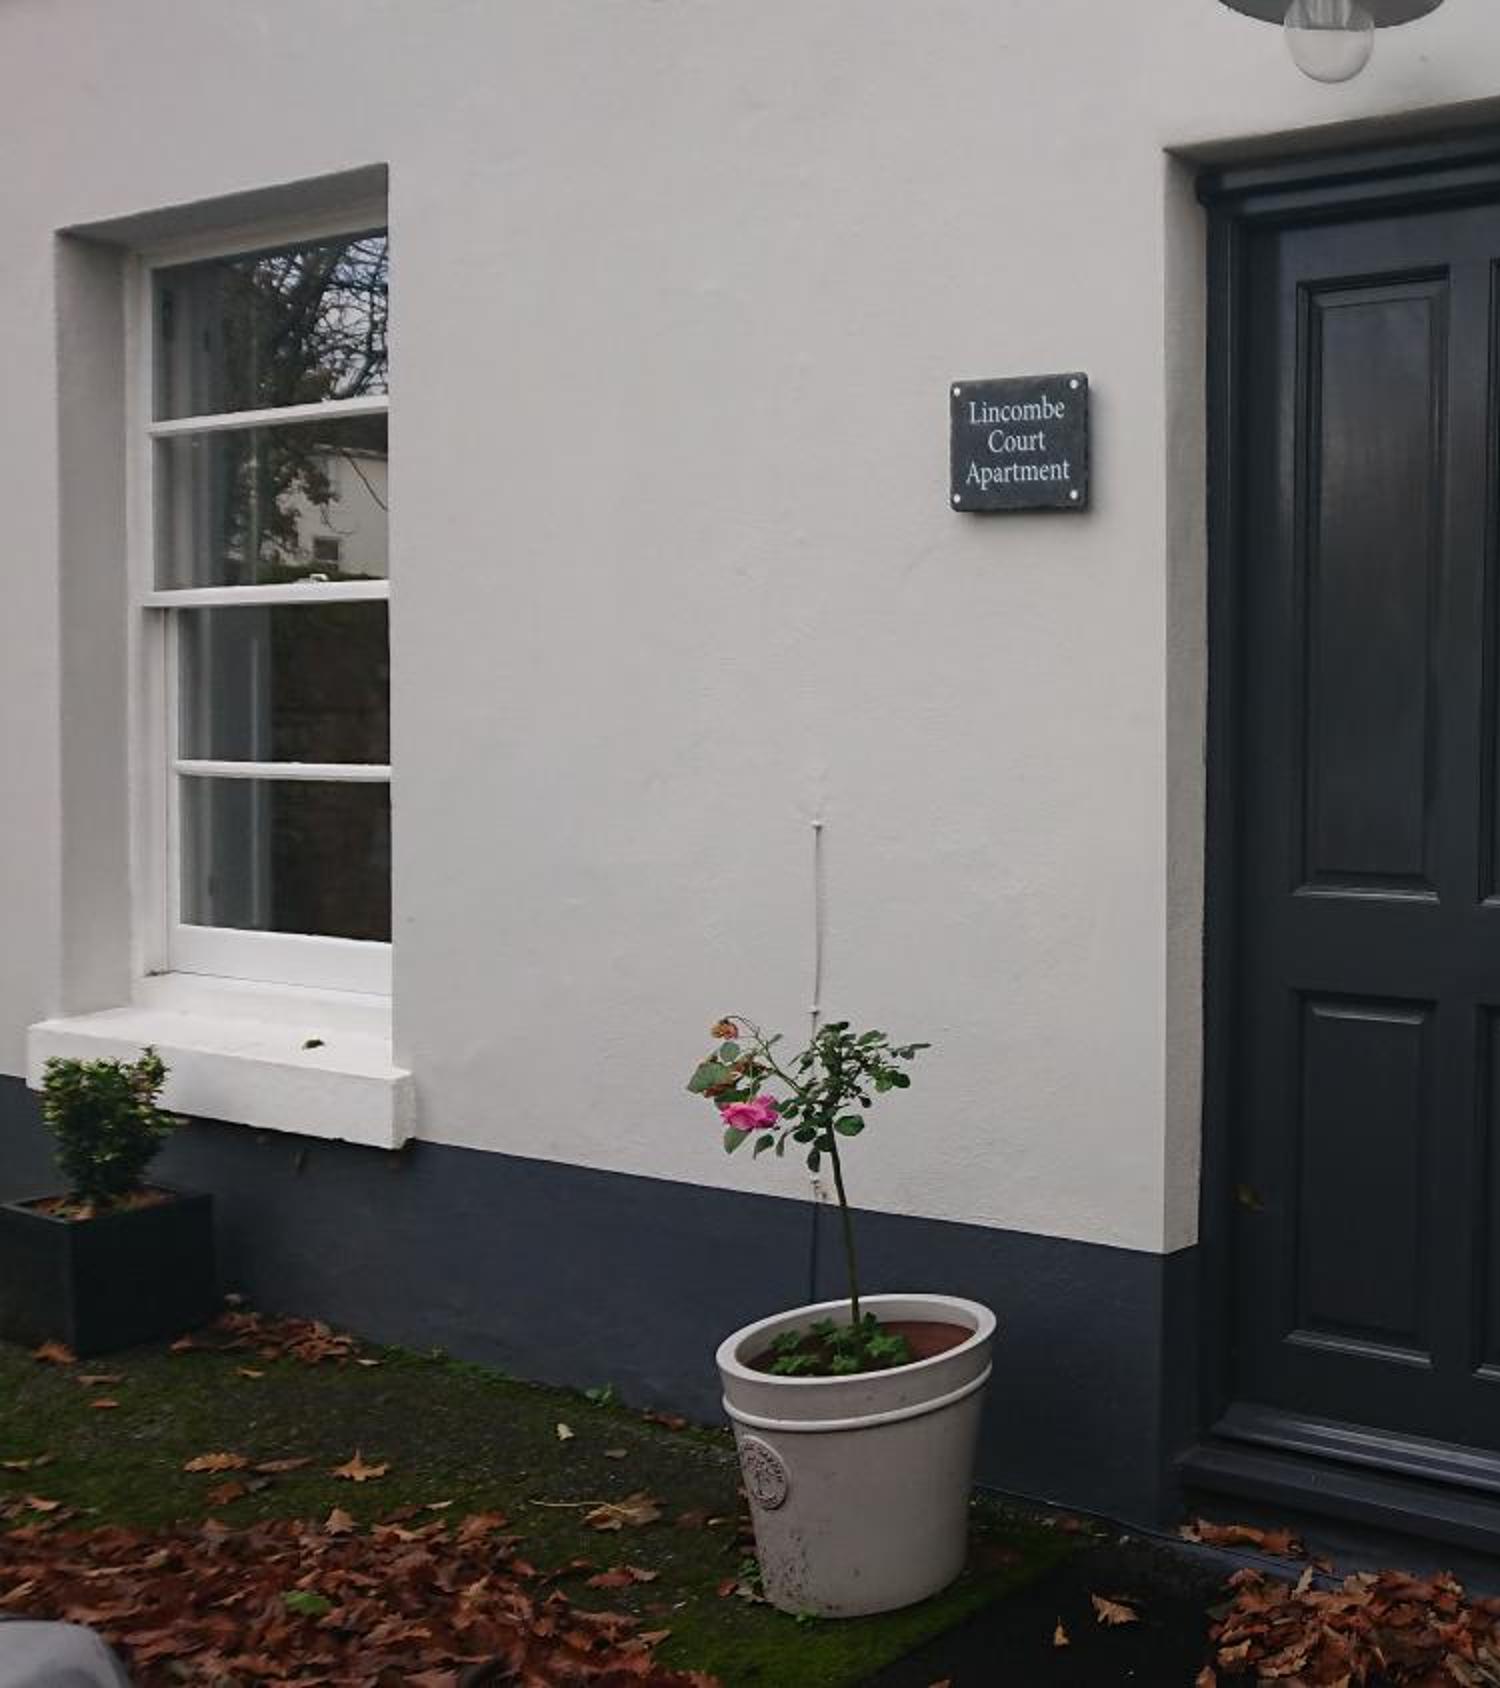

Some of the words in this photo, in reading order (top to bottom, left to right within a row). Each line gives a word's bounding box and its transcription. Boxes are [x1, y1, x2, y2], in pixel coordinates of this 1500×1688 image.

[968, 395, 1065, 424] Lincombe
[987, 429, 1046, 453] Court
[965, 459, 1070, 491] Apartment
